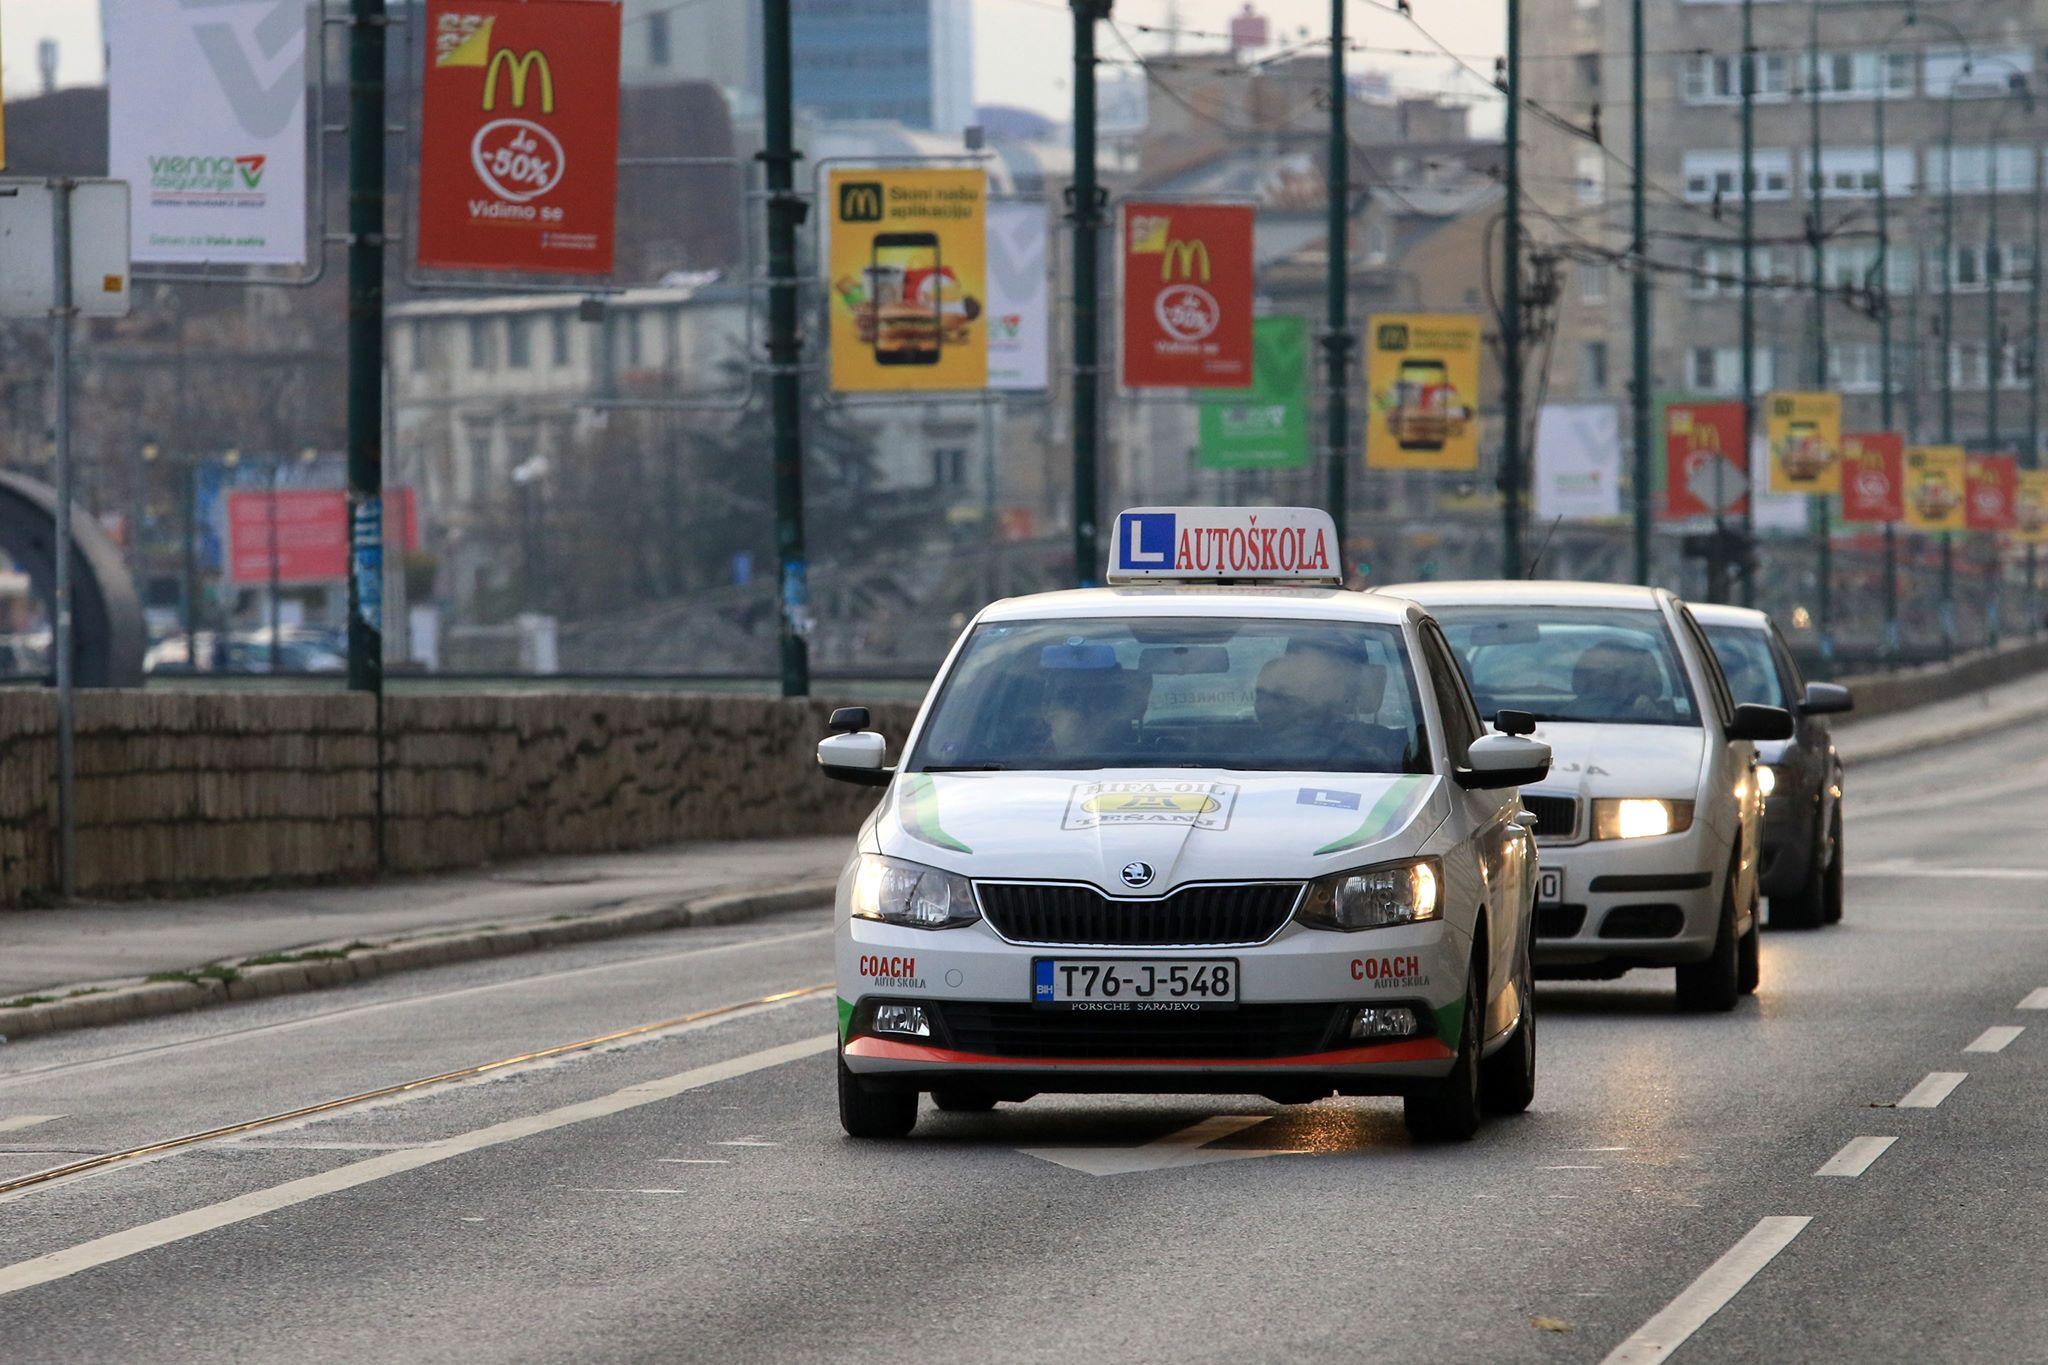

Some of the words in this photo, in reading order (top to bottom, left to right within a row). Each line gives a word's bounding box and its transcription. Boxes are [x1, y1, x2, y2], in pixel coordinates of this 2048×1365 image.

[510, 128, 537, 153] do
[482, 148, 551, 187] -50%
[468, 200, 536, 220] Vidimo
[541, 206, 564, 221] se
[1130, 520, 1165, 562] L
[1175, 515, 1329, 571] AUTOŠKOLA
[860, 955, 915, 977] COACH
[1350, 956, 1419, 980] COACH
[874, 977, 895, 987] AUTO
[1036, 984, 1053, 994] BIH
[1059, 966, 1229, 997] T76-J-548
[1374, 977, 1399, 989] AUTO
[1071, 1002, 1130, 1011] PORSCHE
[1137, 1002, 1200, 1011] SARAJEVO
